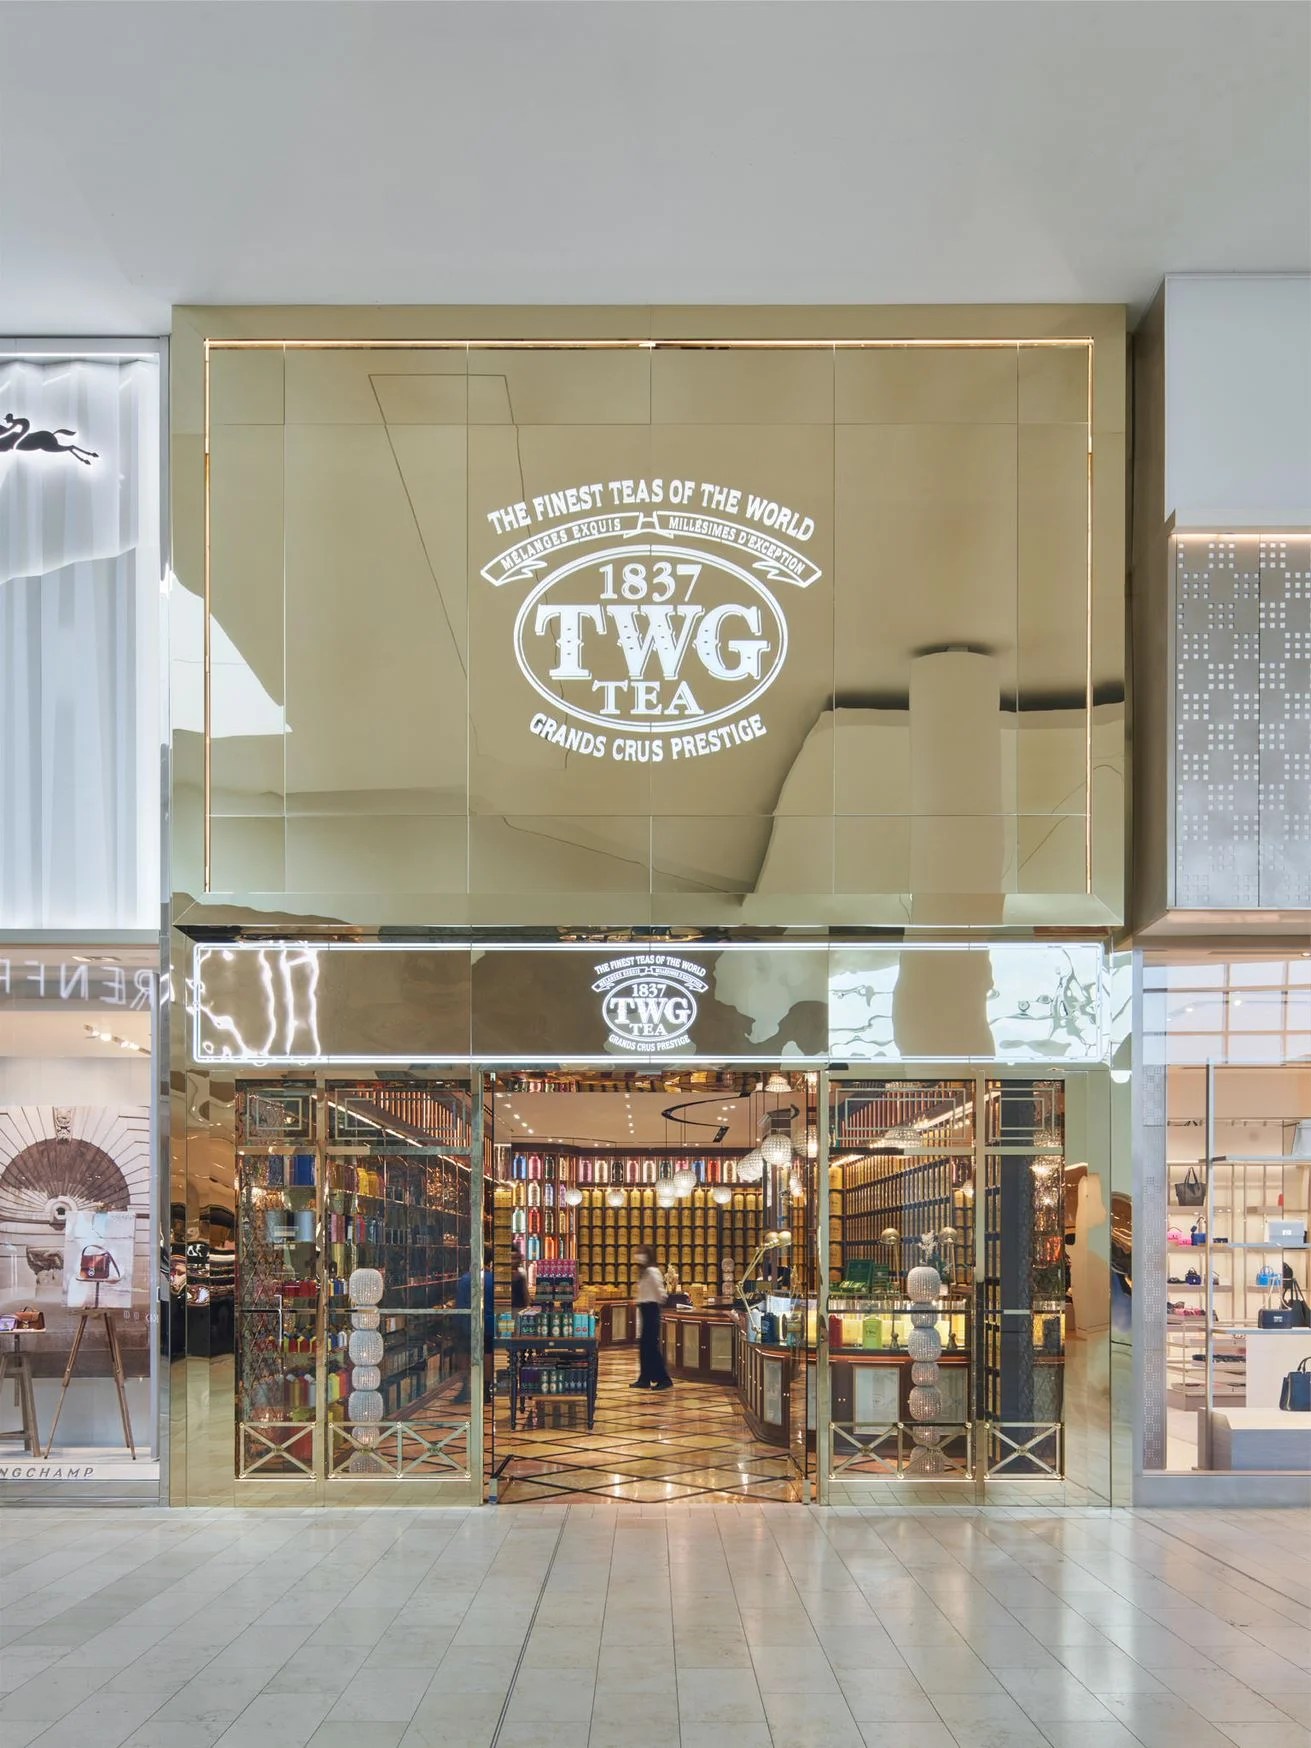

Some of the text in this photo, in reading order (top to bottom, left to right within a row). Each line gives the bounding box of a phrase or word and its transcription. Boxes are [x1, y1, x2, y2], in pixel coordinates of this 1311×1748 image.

[487, 478, 815, 541] THE FINEST TEAS OF THE WORLD
[572, 518, 621, 538] EXQUIS
[737, 531, 806, 575] D'EXCEPTION
[599, 561, 703, 602] 1837
[535, 604, 771, 680] TWG
[592, 680, 704, 715] TEA
[529, 712, 767, 762] GRANDS CRUS PRESTIGE
[594, 963, 609, 975] THE
[610, 957, 635, 970] FINEST
[635, 955, 655, 965] TEAS
[655, 955, 665, 964] OF
[665, 956, 681, 967] THE
[681, 960, 707, 977] WORLD
[632, 983, 667, 998] 1837
[609, 997, 691, 1025] TWG
[608, 1034, 691, 1052] GRANDS CRUS PRESTIGE
[629, 1023, 668, 1036] TEA
